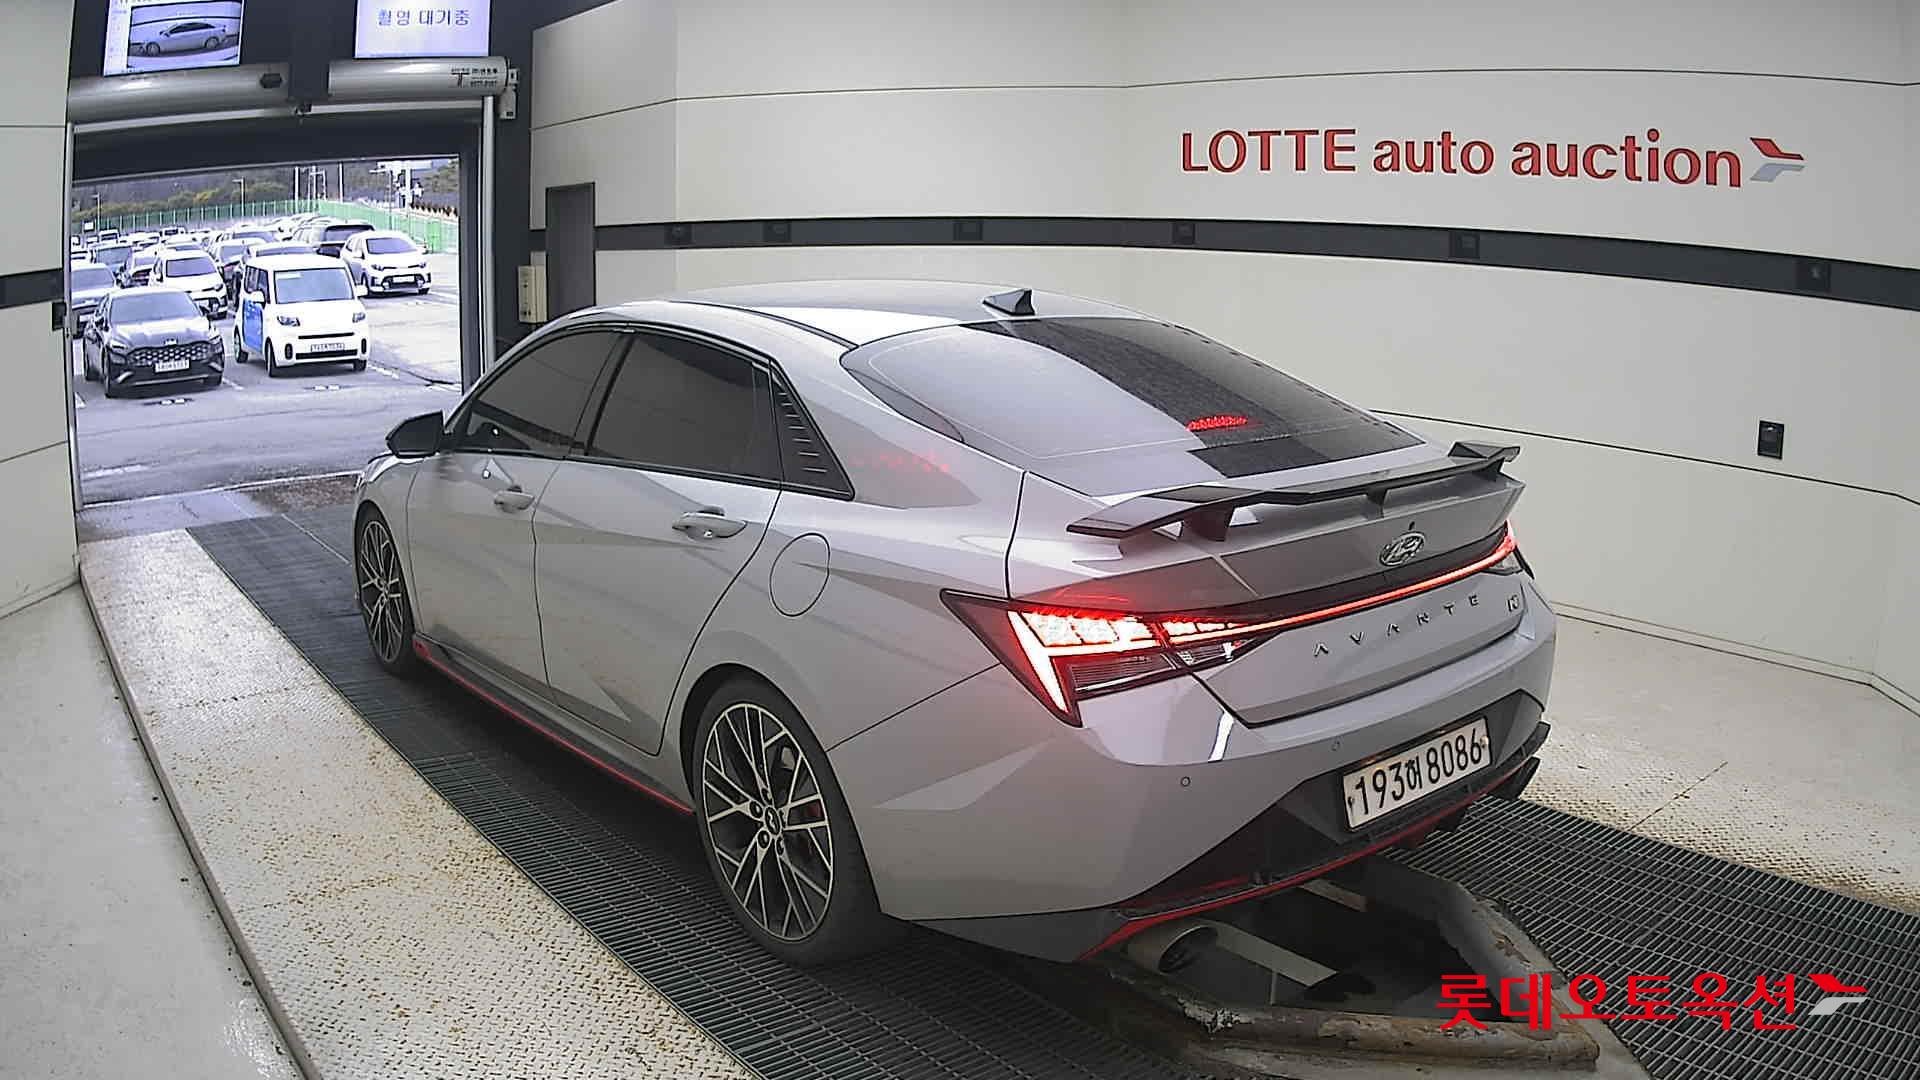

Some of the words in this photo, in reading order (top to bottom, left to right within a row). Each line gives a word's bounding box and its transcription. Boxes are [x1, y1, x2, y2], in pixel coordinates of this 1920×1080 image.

[418, 8, 471, 26] 대기중
[1181, 129, 1357, 172] LOTTE
[1372, 131, 1496, 174] auto
[1511, 127, 1742, 188] auction
[1313, 593, 1479, 658] AVANTE
